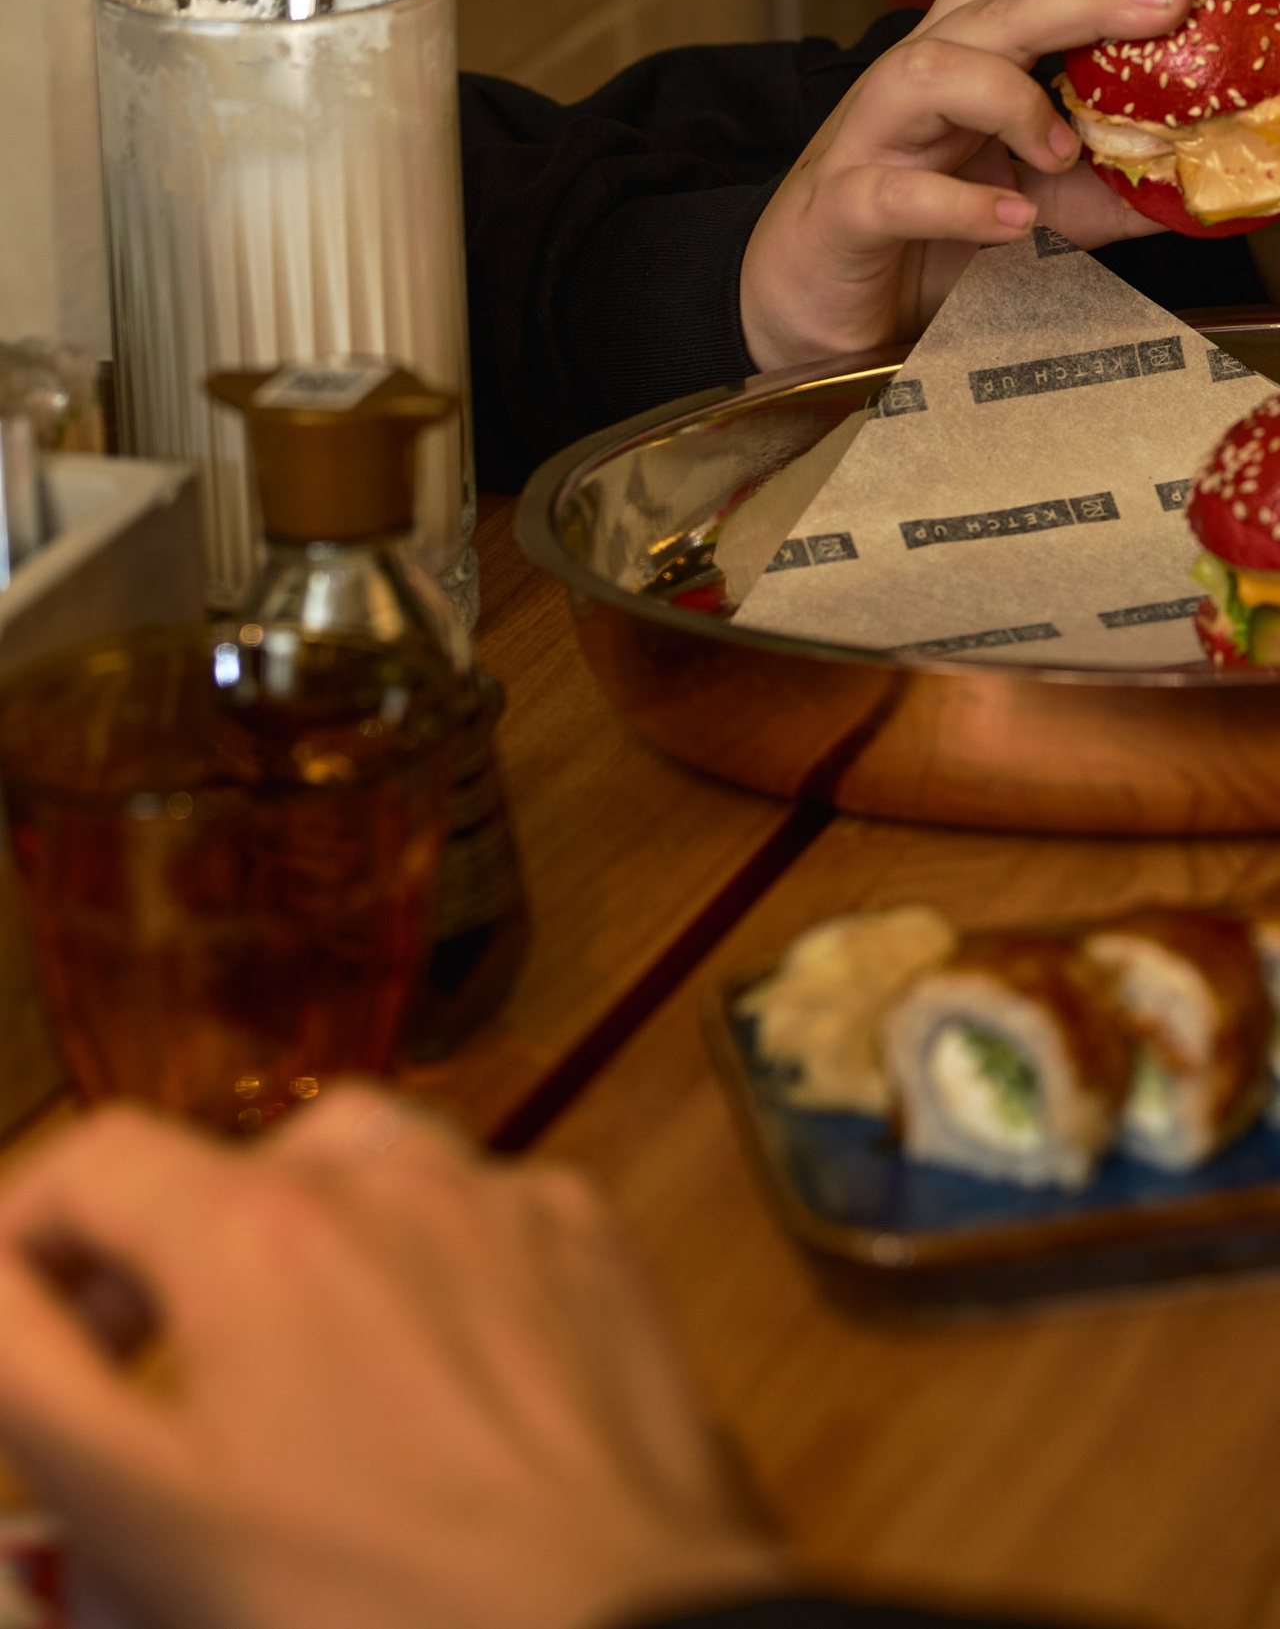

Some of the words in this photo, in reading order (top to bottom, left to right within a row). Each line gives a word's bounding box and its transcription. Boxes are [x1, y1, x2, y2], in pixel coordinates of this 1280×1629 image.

[1034, 356, 1125, 385] KETCH
[983, 375, 1016, 393] UP
[914, 524, 949, 540] UP
[966, 508, 1058, 534] KETCH
